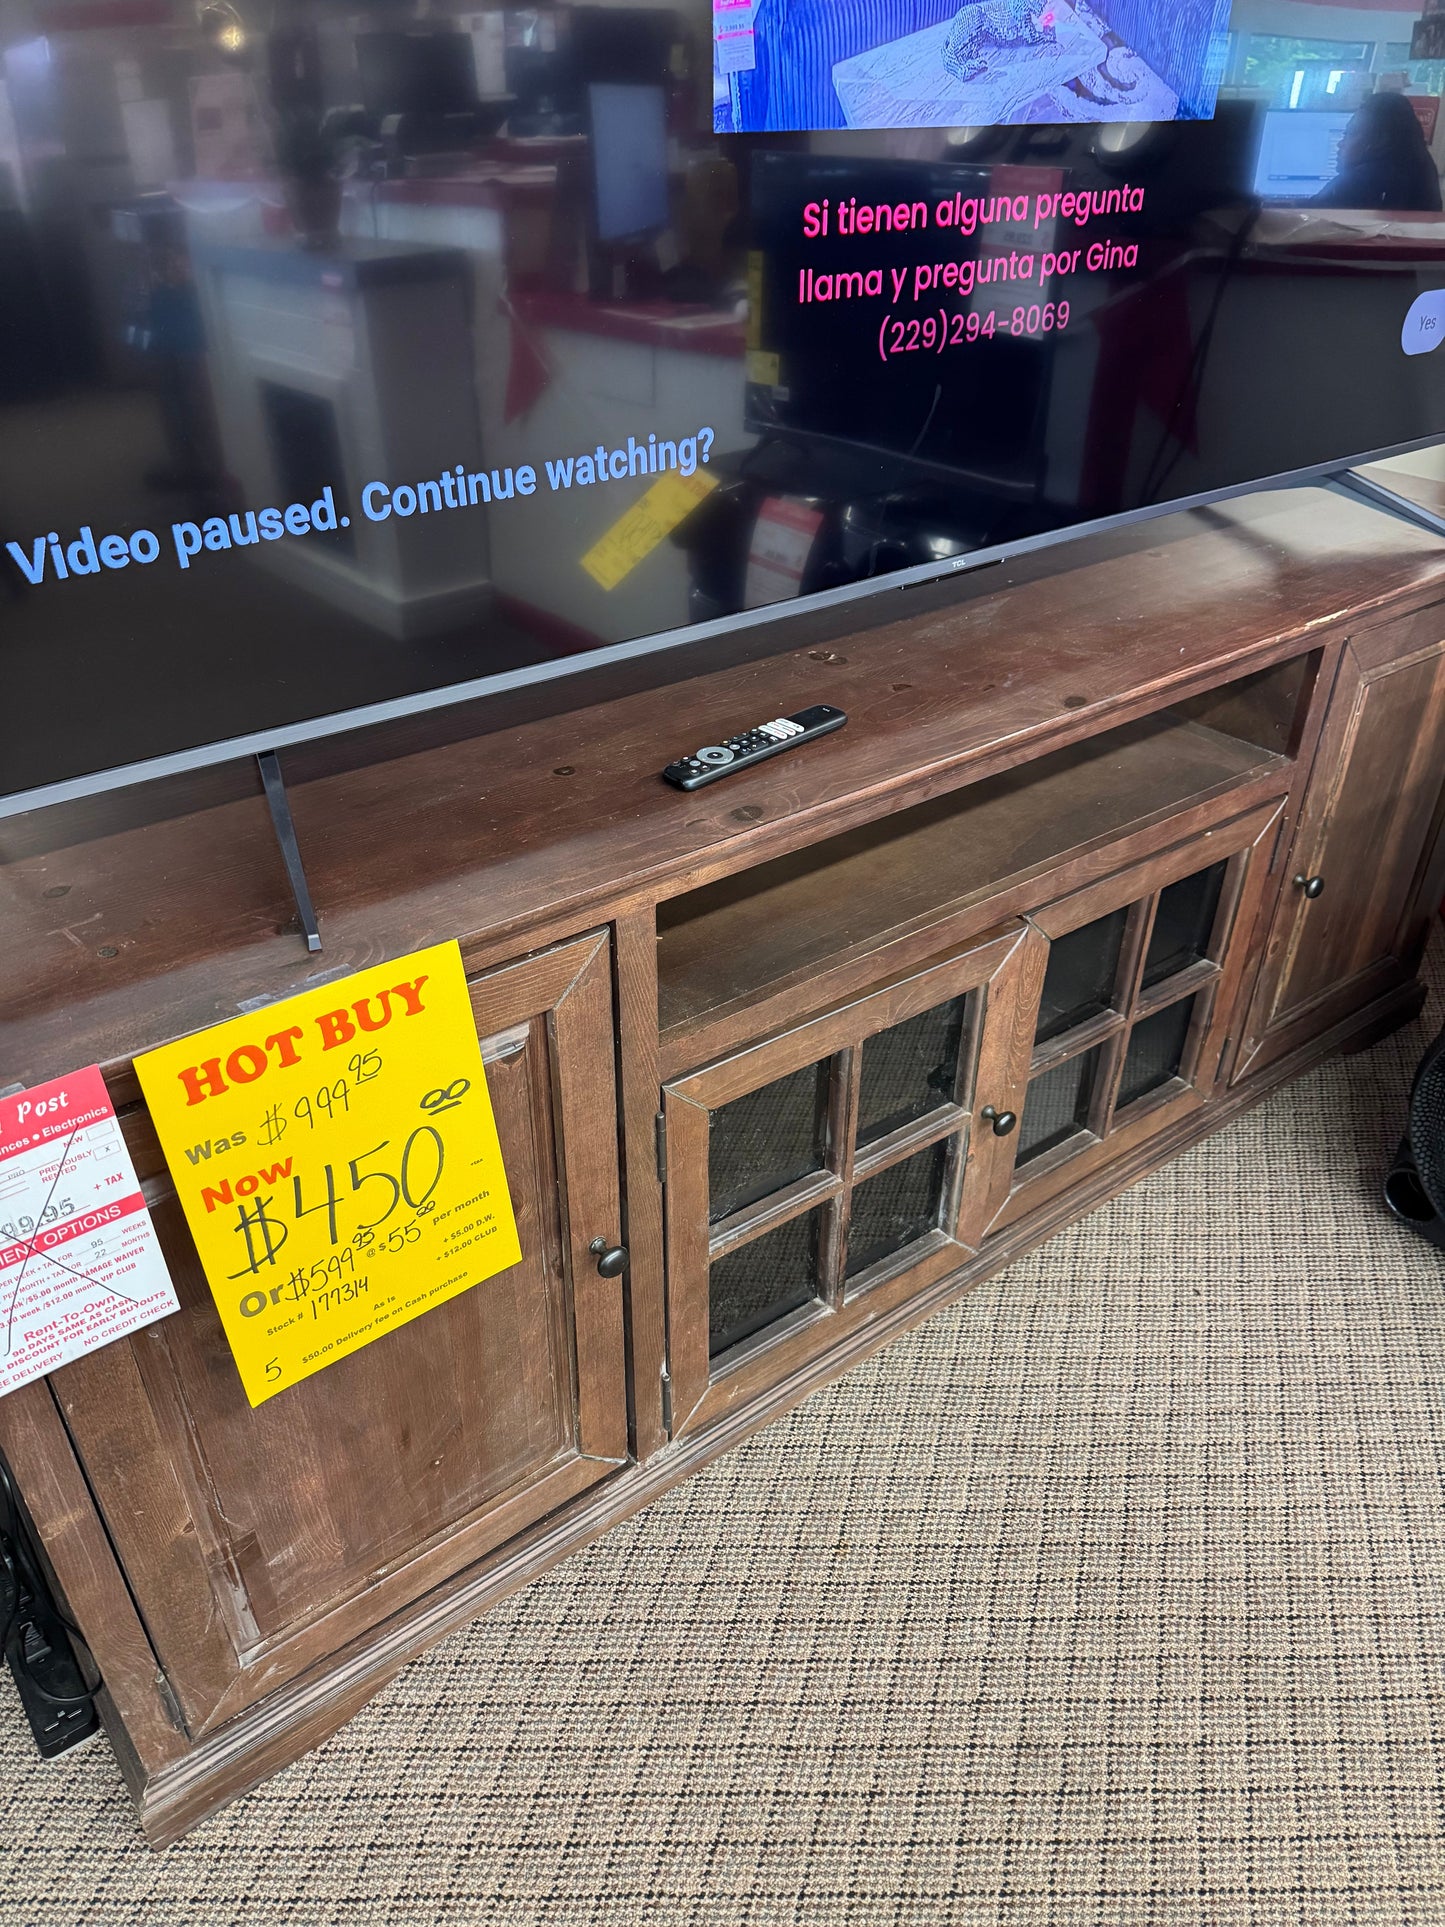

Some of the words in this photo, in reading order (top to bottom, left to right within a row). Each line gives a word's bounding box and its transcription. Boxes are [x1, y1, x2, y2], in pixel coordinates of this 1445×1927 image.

[803, 198, 829, 238] Si
[837, 196, 928, 235] tienen
[935, 191, 1029, 236] alguna
[1033, 183, 1145, 230] pregunta
[799, 268, 883, 303] llama
[891, 266, 908, 304] y
[914, 250, 1034, 301] pregunta
[1039, 249, 1082, 287] por
[1086, 239, 1139, 272] Gina
[878, 300, 1070, 361] (229)294-8069
[1419, 314, 1437, 332] Yes
[5, 524, 160, 586] Video
[171, 485, 351, 569] paused.
[361, 463, 537, 523] Continue
[544, 426, 715, 492] watching?
[951, 559, 967, 569] TCL
[177, 1025, 304, 1107] HOT
[314, 975, 430, 1052] BUY
[16, 1090, 69, 1124] Post
[41, 1105, 109, 1138] Electronics
[39, 1148, 94, 1177] PREVIOUSLY
[63, 1135, 84, 1149] NEW
[184, 1130, 248, 1167] Was
[42, 1164, 78, 1184] RENTED
[104, 1171, 125, 1187] TAX
[200, 1155, 294, 1214] Now
[43, 1204, 122, 1247] OPTIONS
[121, 1219, 148, 1235] WEEKS
[443, 1240, 473, 1258] $12.00
[474, 1225, 498, 1242] CLUB
[450, 1223, 474, 1241] $5.00
[476, 1213, 496, 1227] D.W.
[19, 1277, 46, 1294] MONTH
[52, 1268, 67, 1279] TAX
[94, 1248, 107, 1259] 22
[121, 1231, 151, 1249] MONTHS
[53, 1275, 79, 1292] month
[114, 1245, 145, 1264] WAIVER
[239, 1283, 285, 1318] Or
[366, 1247, 376, 1258] @
[432, 1208, 452, 1226] per
[454, 1190, 490, 1213] month
[20, 1306, 41, 1321] week
[100, 1271, 115, 1283] VIP
[116, 1261, 137, 1277] CLUB
[373, 1301, 386, 1311] As
[6, 1338, 61, 1370] DISCOUNT
[63, 1328, 84, 1343] FOR
[86, 1312, 117, 1332] EARLY
[119, 1290, 167, 1317] BUYOUTS
[12, 1347, 26, 1359] 90
[27, 1333, 56, 1351] DAYS
[57, 1318, 87, 1337] SAME
[89, 1310, 103, 1322] AS
[104, 1296, 133, 1314] CASH
[23, 1294, 116, 1343] Rent-To-Own
[266, 1318, 297, 1336] Stock
[301, 1342, 335, 1364] $50.00
[336, 1322, 374, 1347] Delivery
[374, 1312, 390, 1325] fee
[391, 1306, 404, 1316] on
[404, 1293, 428, 1309] Cash
[429, 1270, 469, 1297] purchase
[12, 1351, 63, 1382] DELIVERY
[83, 1335, 100, 1347] NO
[101, 1316, 138, 1338] CREDIT
[140, 1298, 175, 1320] CHECK
[264, 1356, 283, 1383] 5
